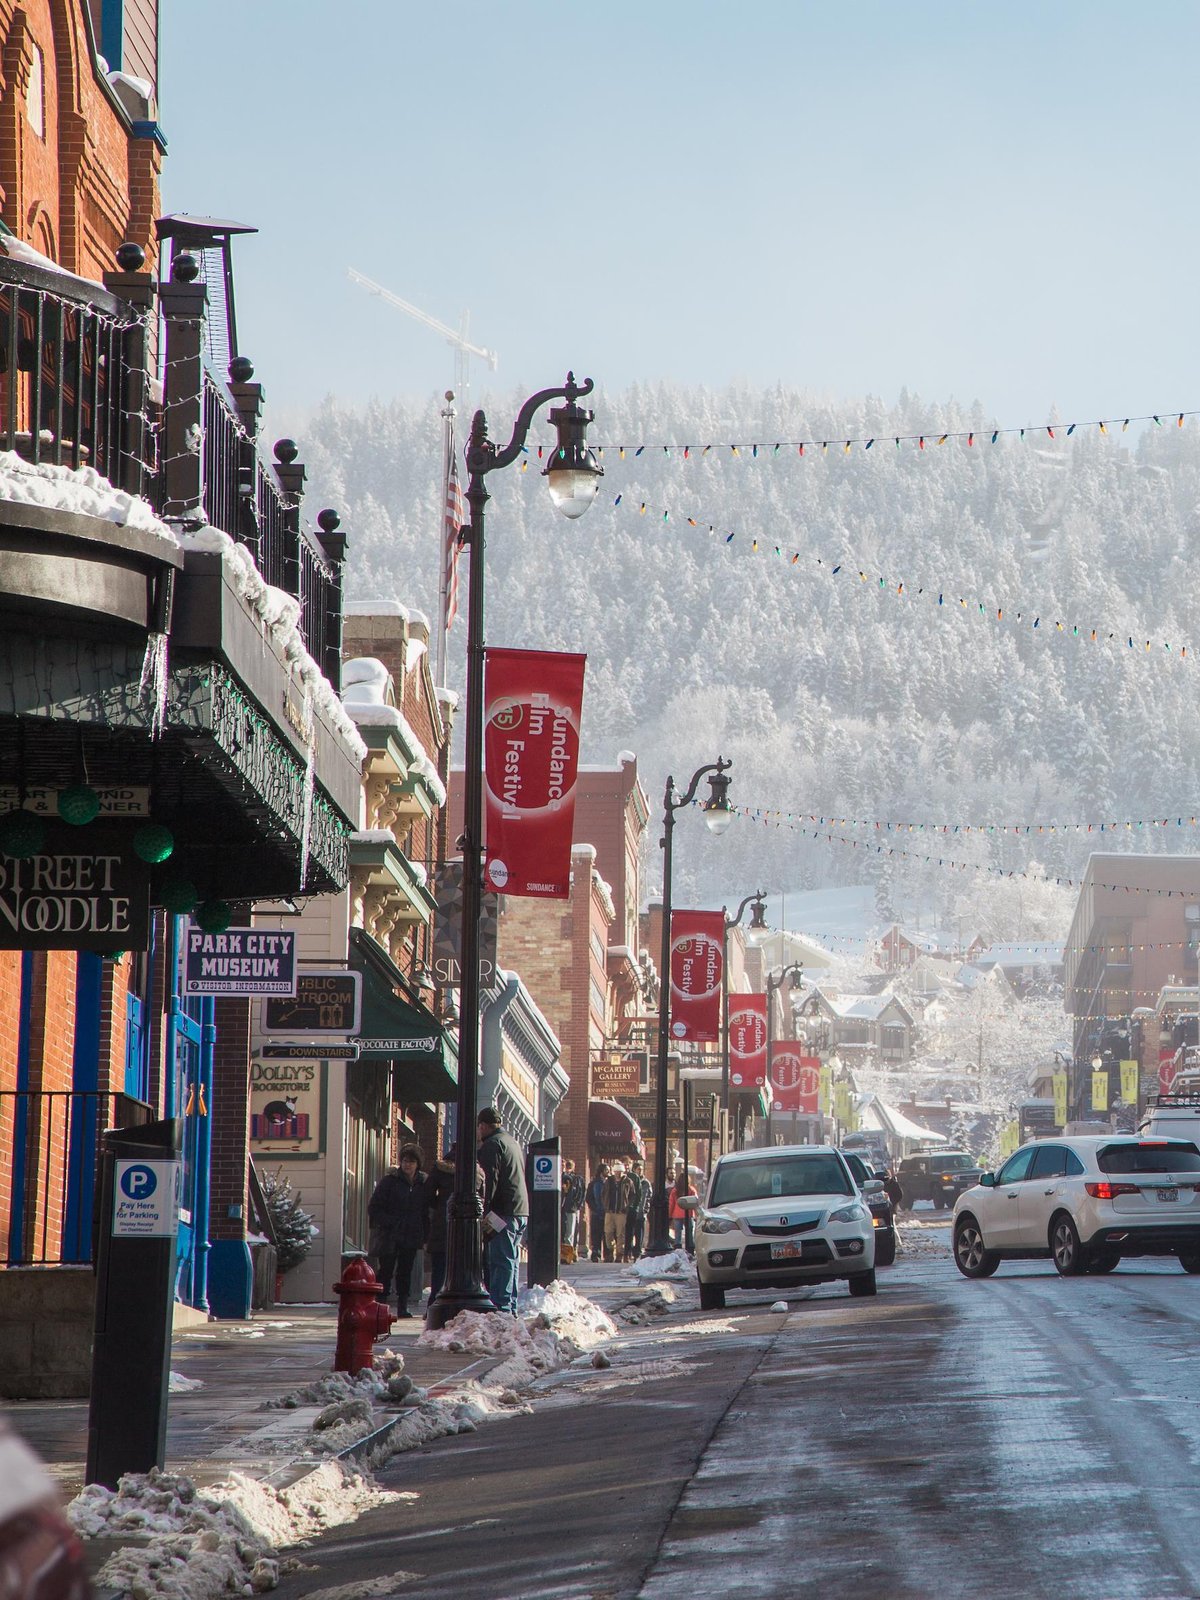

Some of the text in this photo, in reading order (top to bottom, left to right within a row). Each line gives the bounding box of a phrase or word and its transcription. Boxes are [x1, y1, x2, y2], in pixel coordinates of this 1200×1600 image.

[190, 934, 291, 955] PARK CITY
[201, 957, 280, 977] MUSEUM
[434, 958, 493, 983] SILR
[200, 981, 290, 991] VISITOR INFORMATION
[271, 992, 351, 1004] RESTROOM
[289, 1048, 352, 1056] DOWNSTAIRS
[250, 1063, 315, 1081] DOLLY'S
[251, 1082, 310, 1092] BOOKSTORE
[540, 1160, 549, 1171] P
[129, 1171, 148, 1194] P
[120, 1202, 135, 1210] Pay
[129, 1212, 159, 1220] Parking
